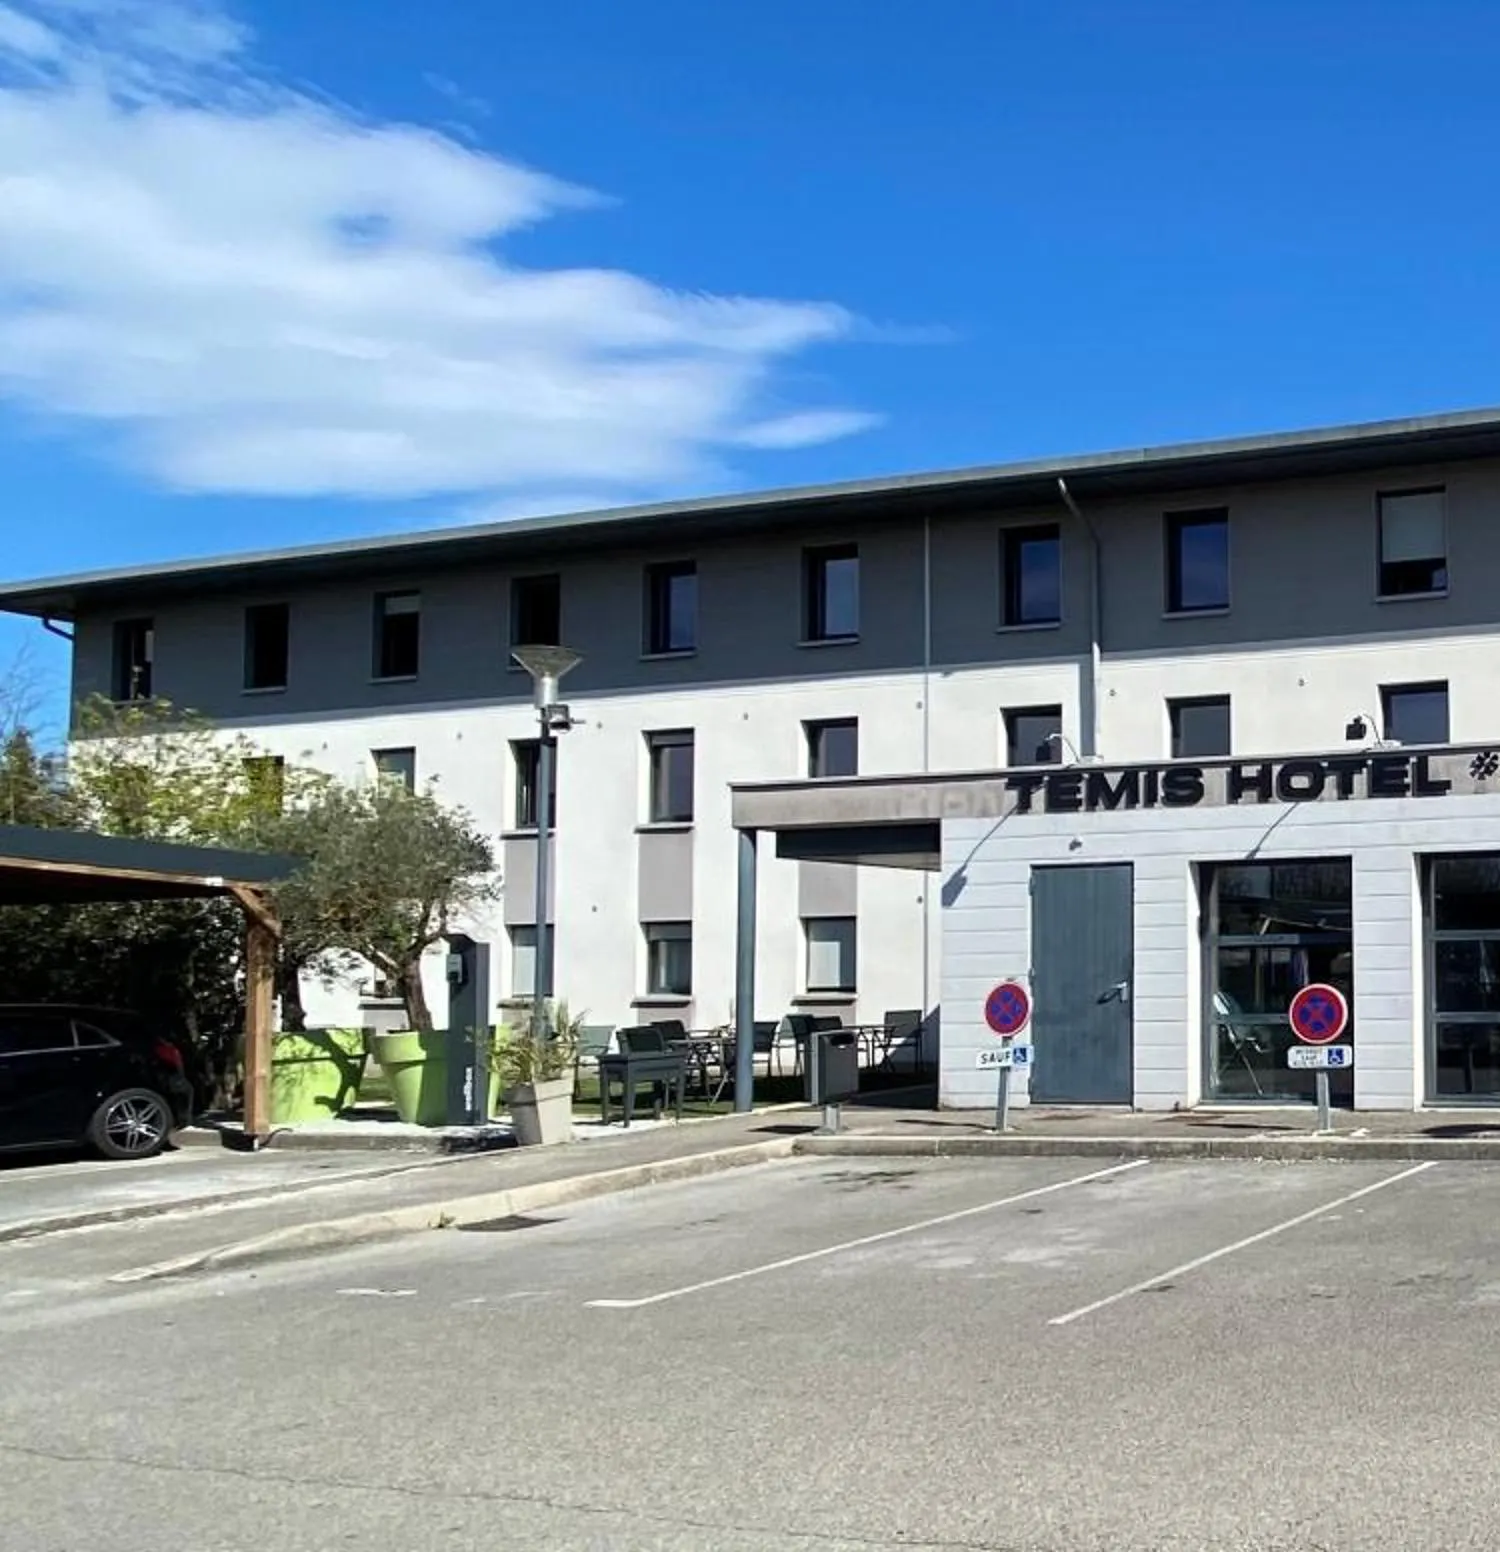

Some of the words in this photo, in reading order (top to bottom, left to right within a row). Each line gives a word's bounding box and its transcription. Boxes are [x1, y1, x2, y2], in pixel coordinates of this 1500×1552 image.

[1004, 767, 1204, 814] TEMIS
[1226, 755, 1452, 804] HOTEL
[980, 1051, 1011, 1065] SAUF
